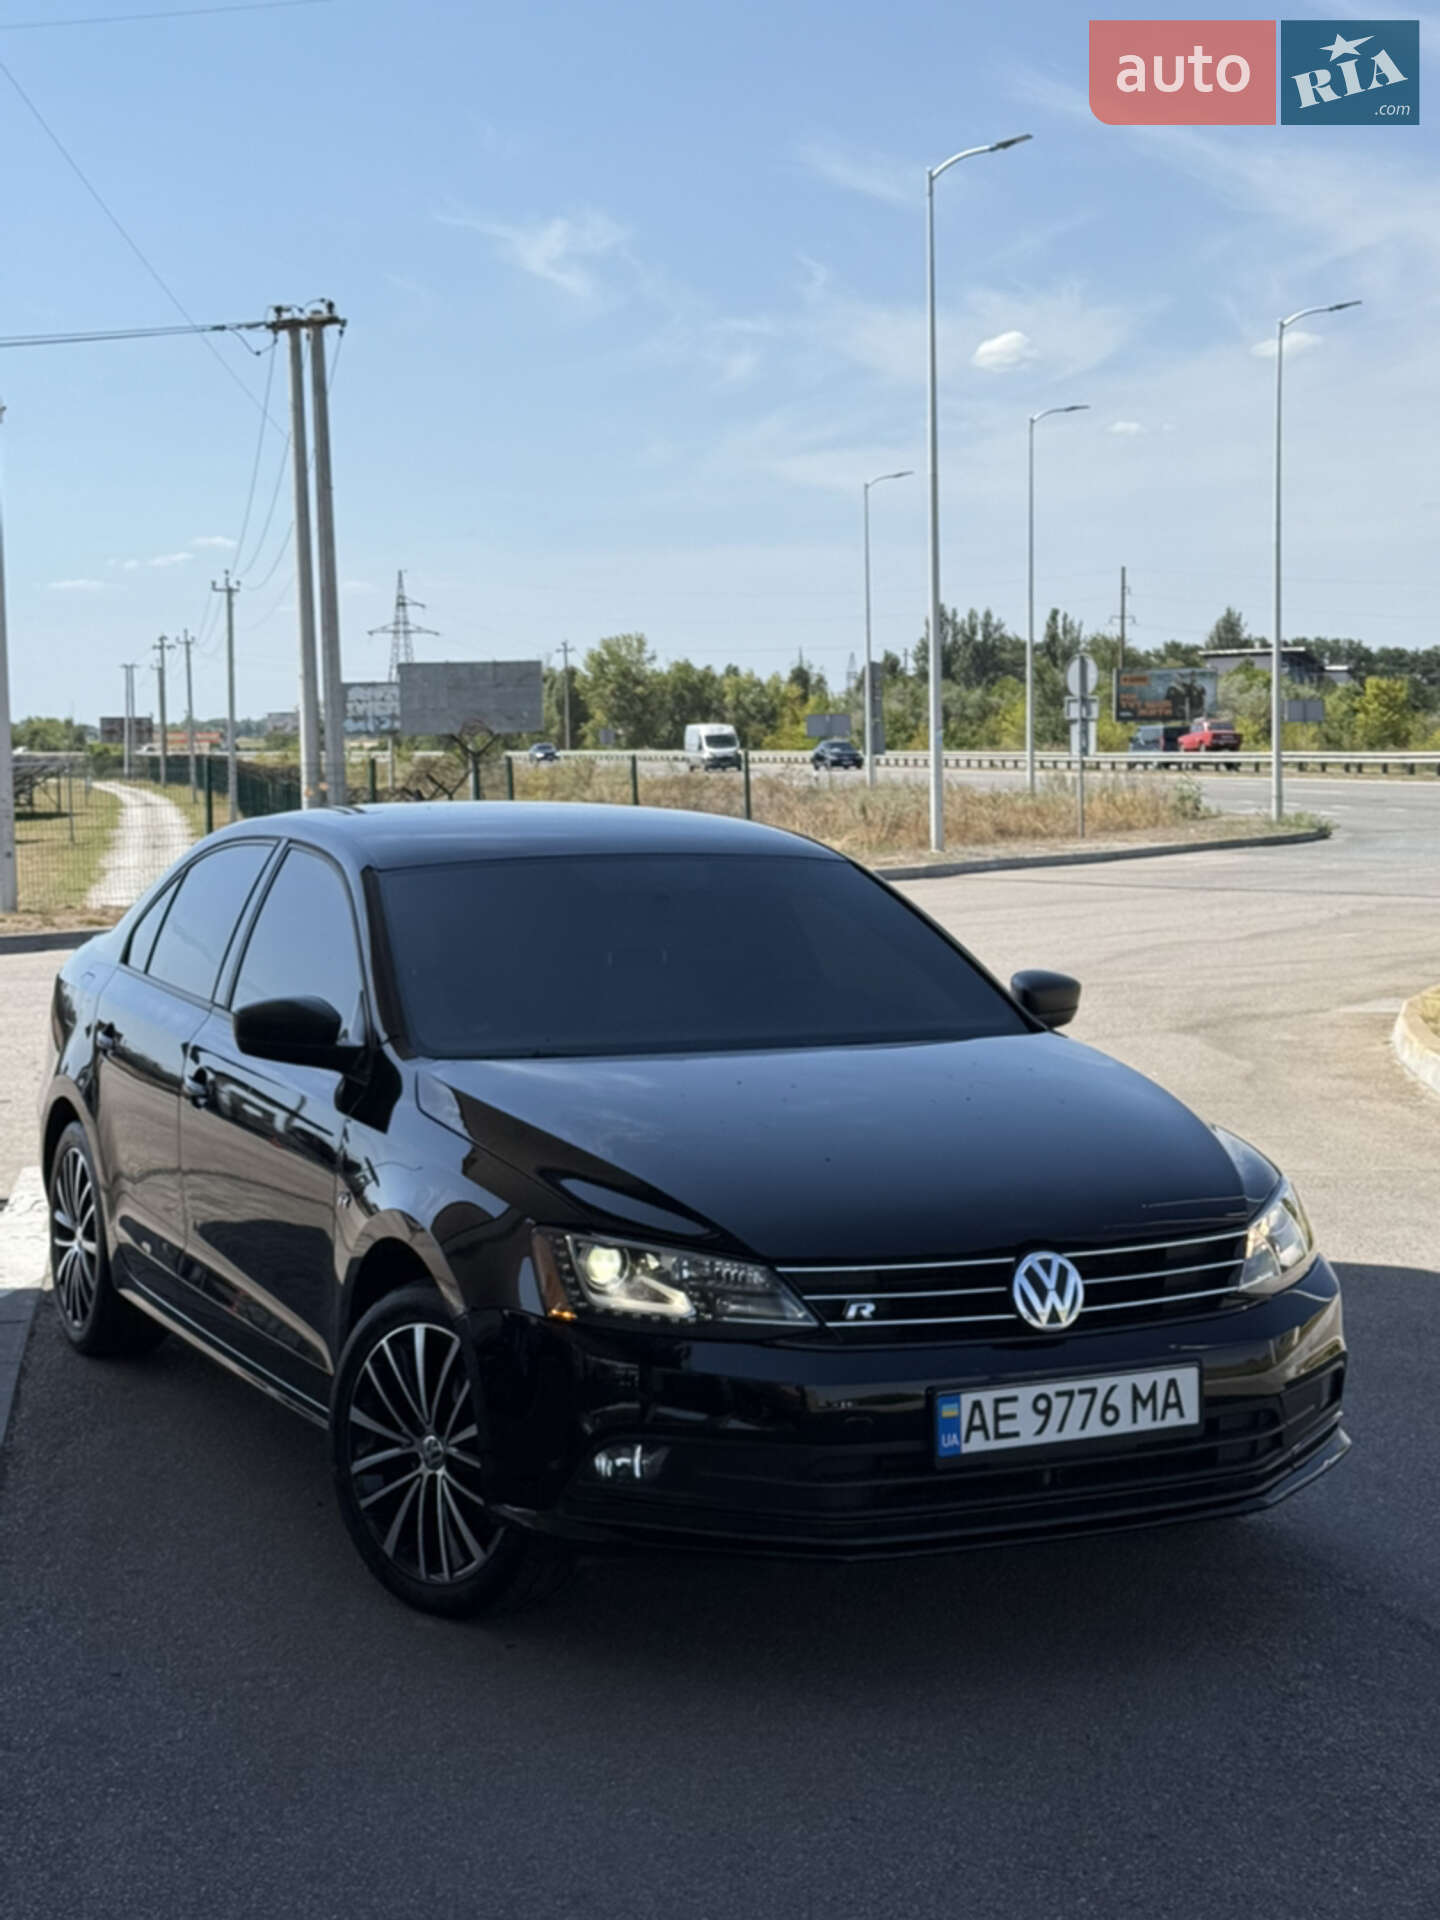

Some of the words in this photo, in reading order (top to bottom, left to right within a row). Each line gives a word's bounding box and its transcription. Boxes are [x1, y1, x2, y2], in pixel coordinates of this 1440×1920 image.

[846, 1300, 875, 1319] R
[963, 1394, 1021, 1444] AE
[1031, 1384, 1121, 1437] 9776
[1131, 1377, 1185, 1424] MA
[941, 1432, 960, 1448] UA
